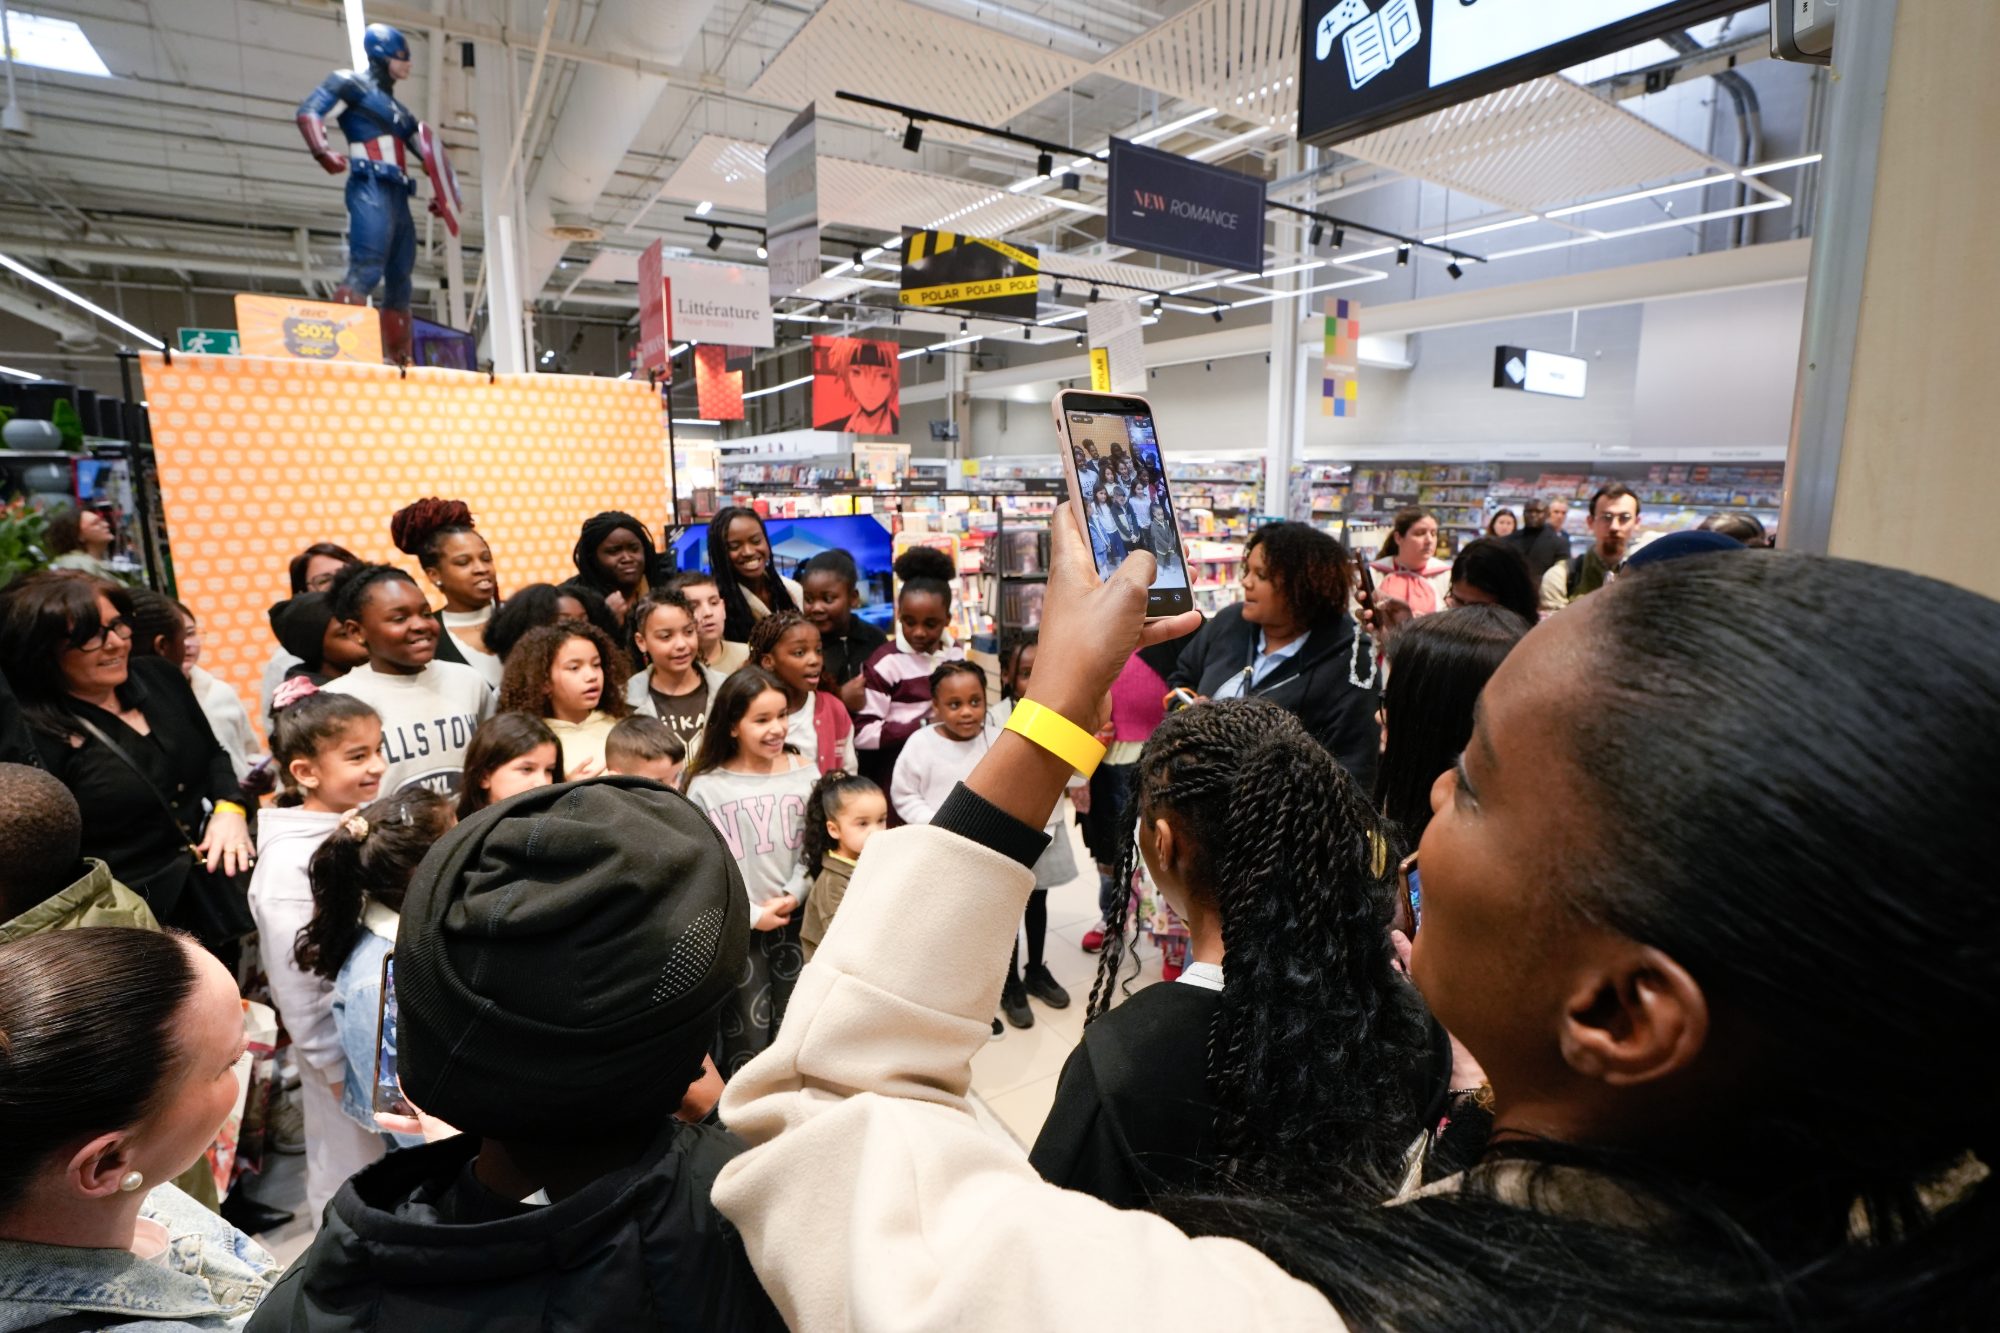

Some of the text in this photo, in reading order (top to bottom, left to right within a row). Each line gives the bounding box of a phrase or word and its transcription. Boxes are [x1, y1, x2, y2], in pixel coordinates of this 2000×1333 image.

[1134, 189, 1238, 230] NEW ROMANCE
[921, 288, 959, 303] POLAR
[966, 283, 1001, 297] POLAR
[678, 298, 760, 321] Littérature
[291, 322, 334, 339] -50%
[708, 794, 805, 861] NYC
